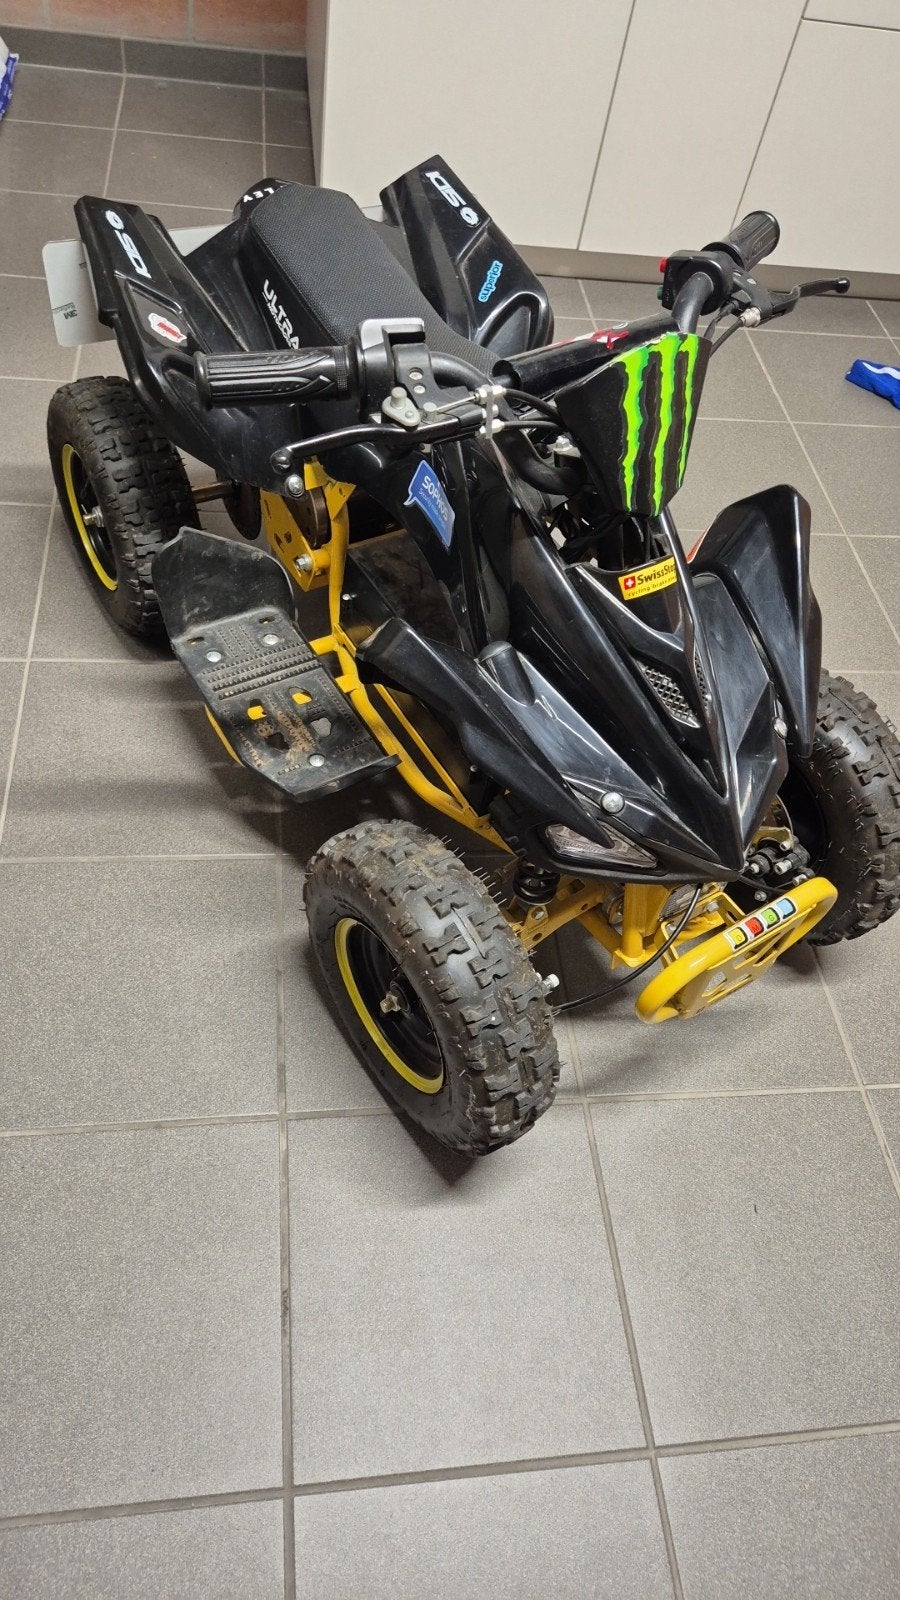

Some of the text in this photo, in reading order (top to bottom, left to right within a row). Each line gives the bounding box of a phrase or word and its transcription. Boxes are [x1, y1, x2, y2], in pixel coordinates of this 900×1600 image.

[243, 187, 275, 203] LEY
[480, 262, 501, 301] superior
[263, 279, 299, 350] ULTRA
[421, 475, 448, 522] SOPHOS
[628, 585, 651, 597] cycling
